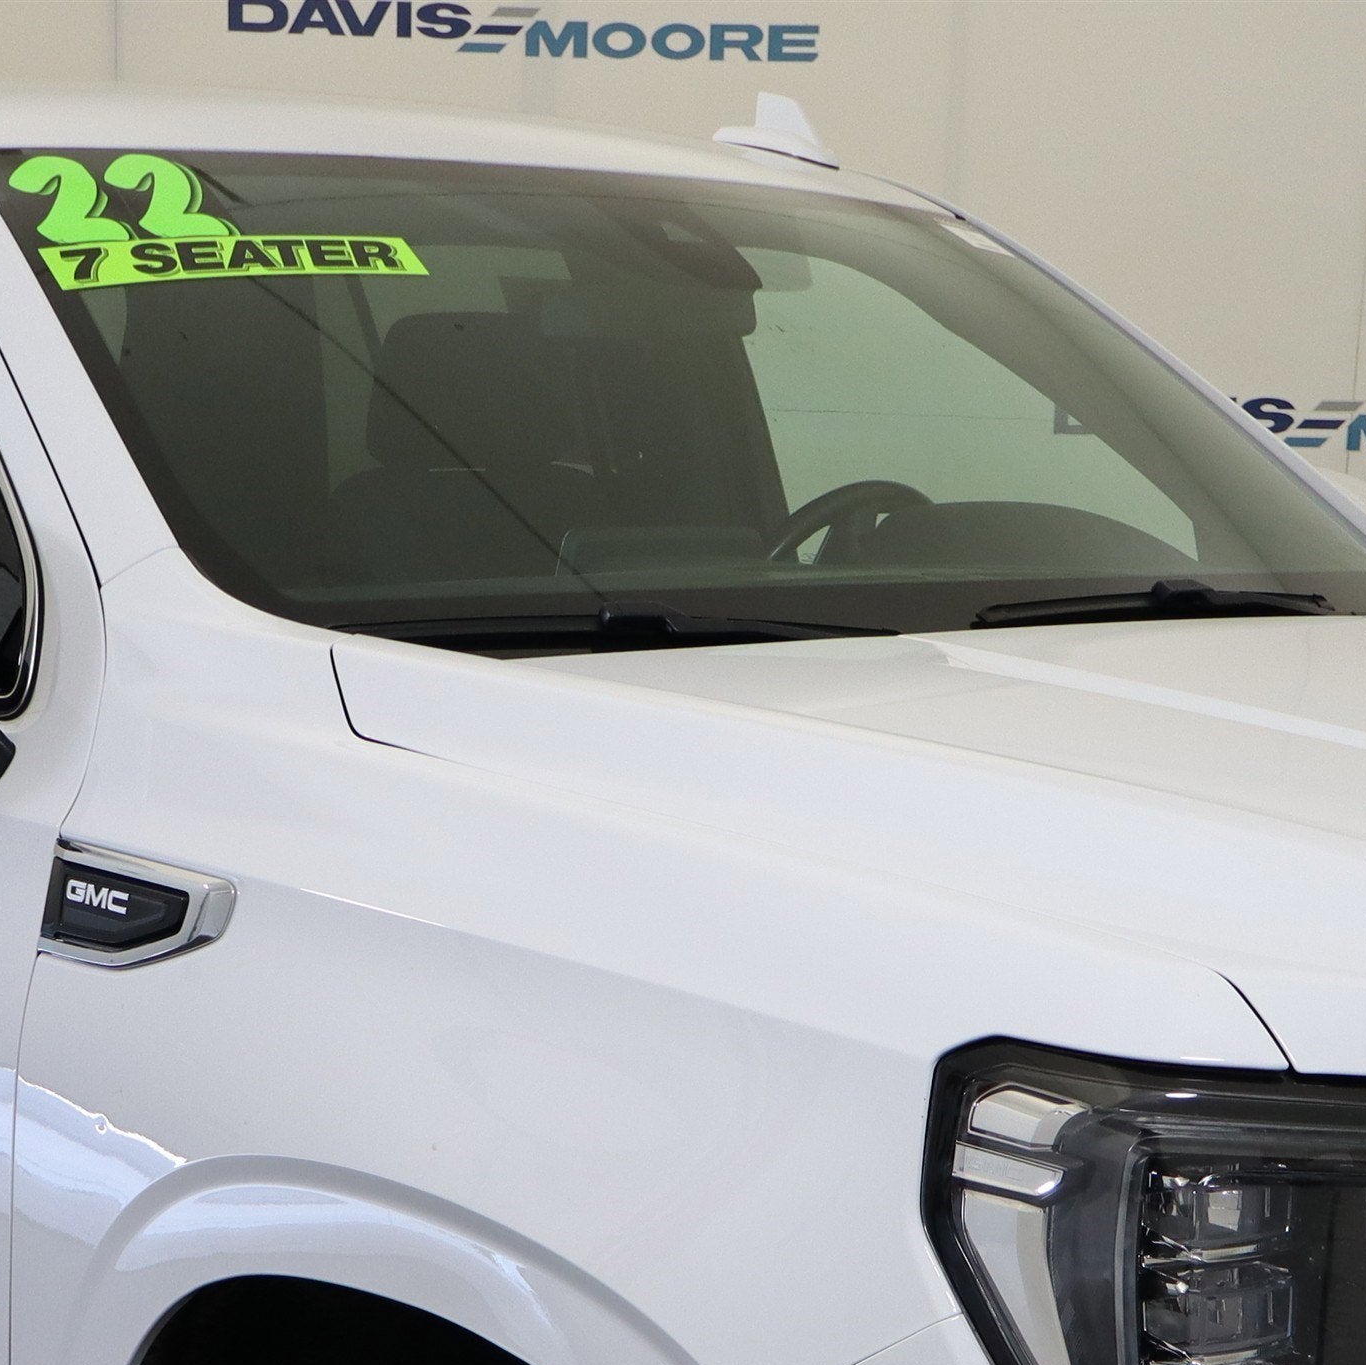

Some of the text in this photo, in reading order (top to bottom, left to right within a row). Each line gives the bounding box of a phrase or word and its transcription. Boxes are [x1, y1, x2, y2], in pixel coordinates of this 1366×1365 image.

[228, 0, 821, 62] DAVIS MOORE
[9, 153, 239, 244] 22
[59, 239, 407, 282] 7 SEATER
[65, 878, 130, 915] GMC
